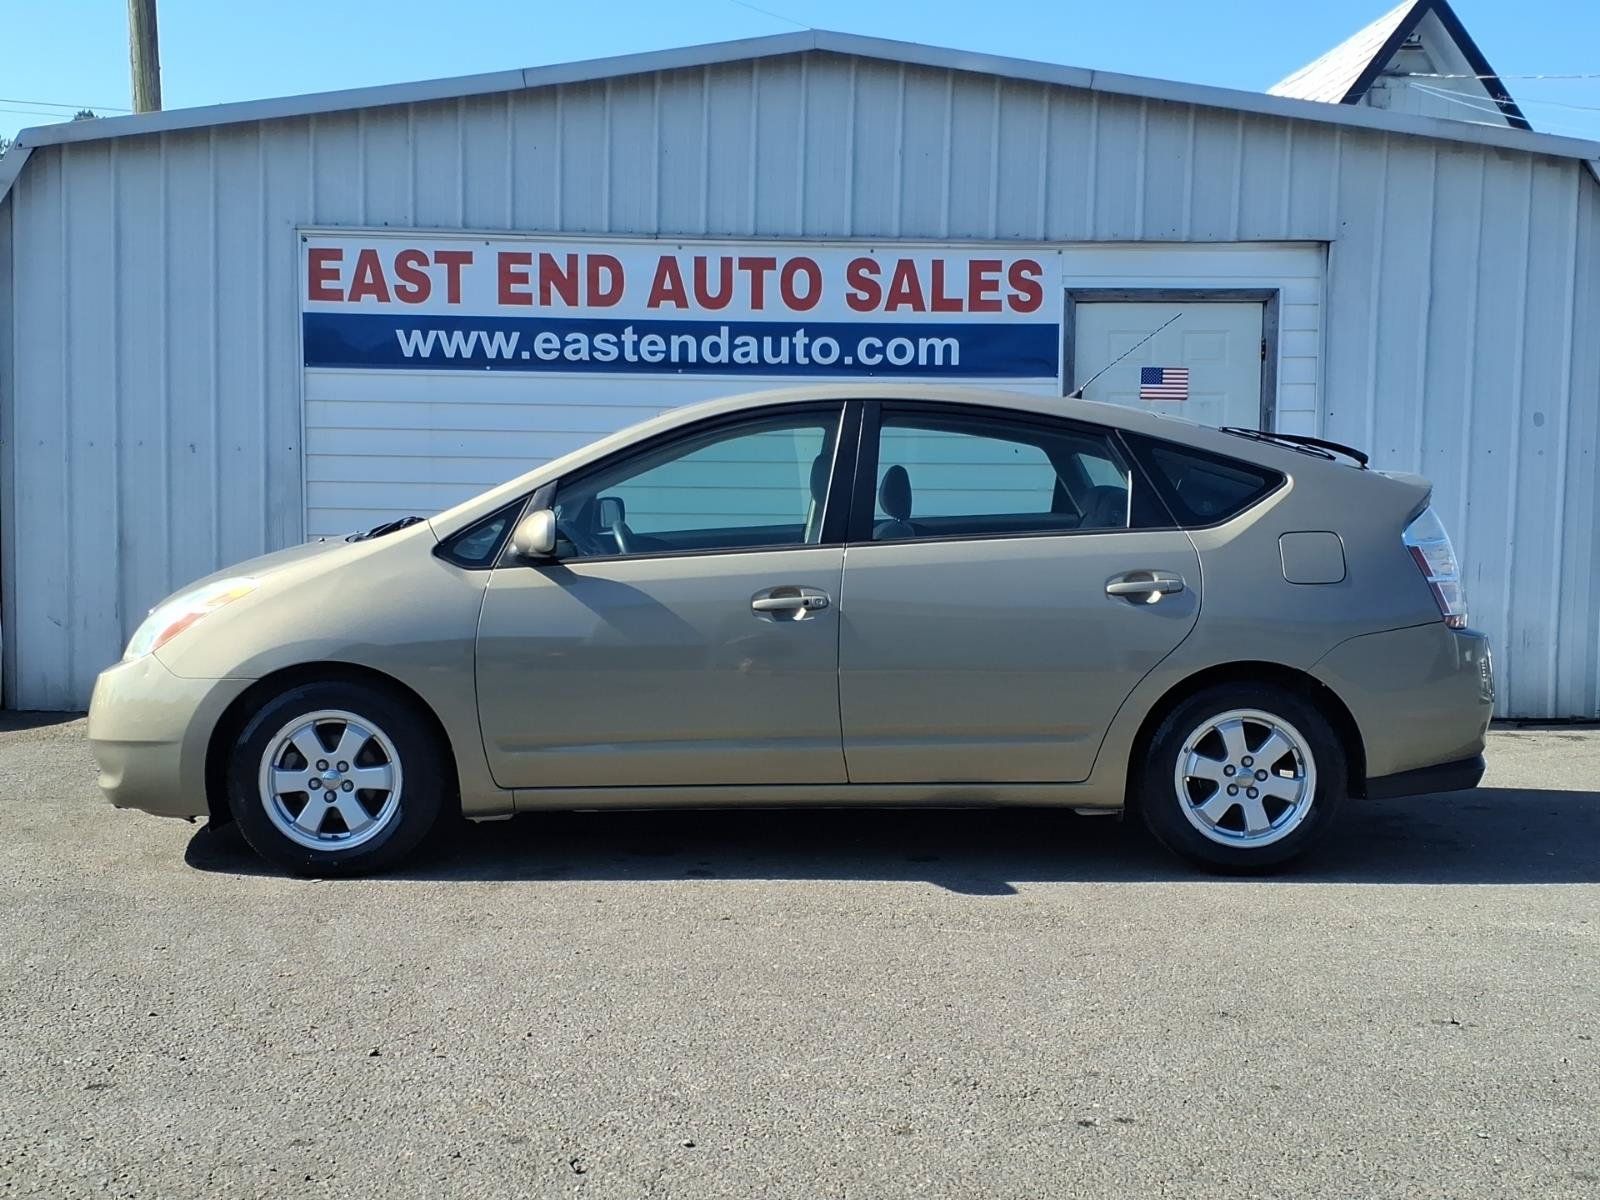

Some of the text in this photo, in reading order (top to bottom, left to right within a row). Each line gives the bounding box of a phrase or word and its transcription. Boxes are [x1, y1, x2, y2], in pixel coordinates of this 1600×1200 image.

[307, 247, 1044, 313] EAST END AUTO SALES
[395, 325, 960, 366] www.eastendauto.com
